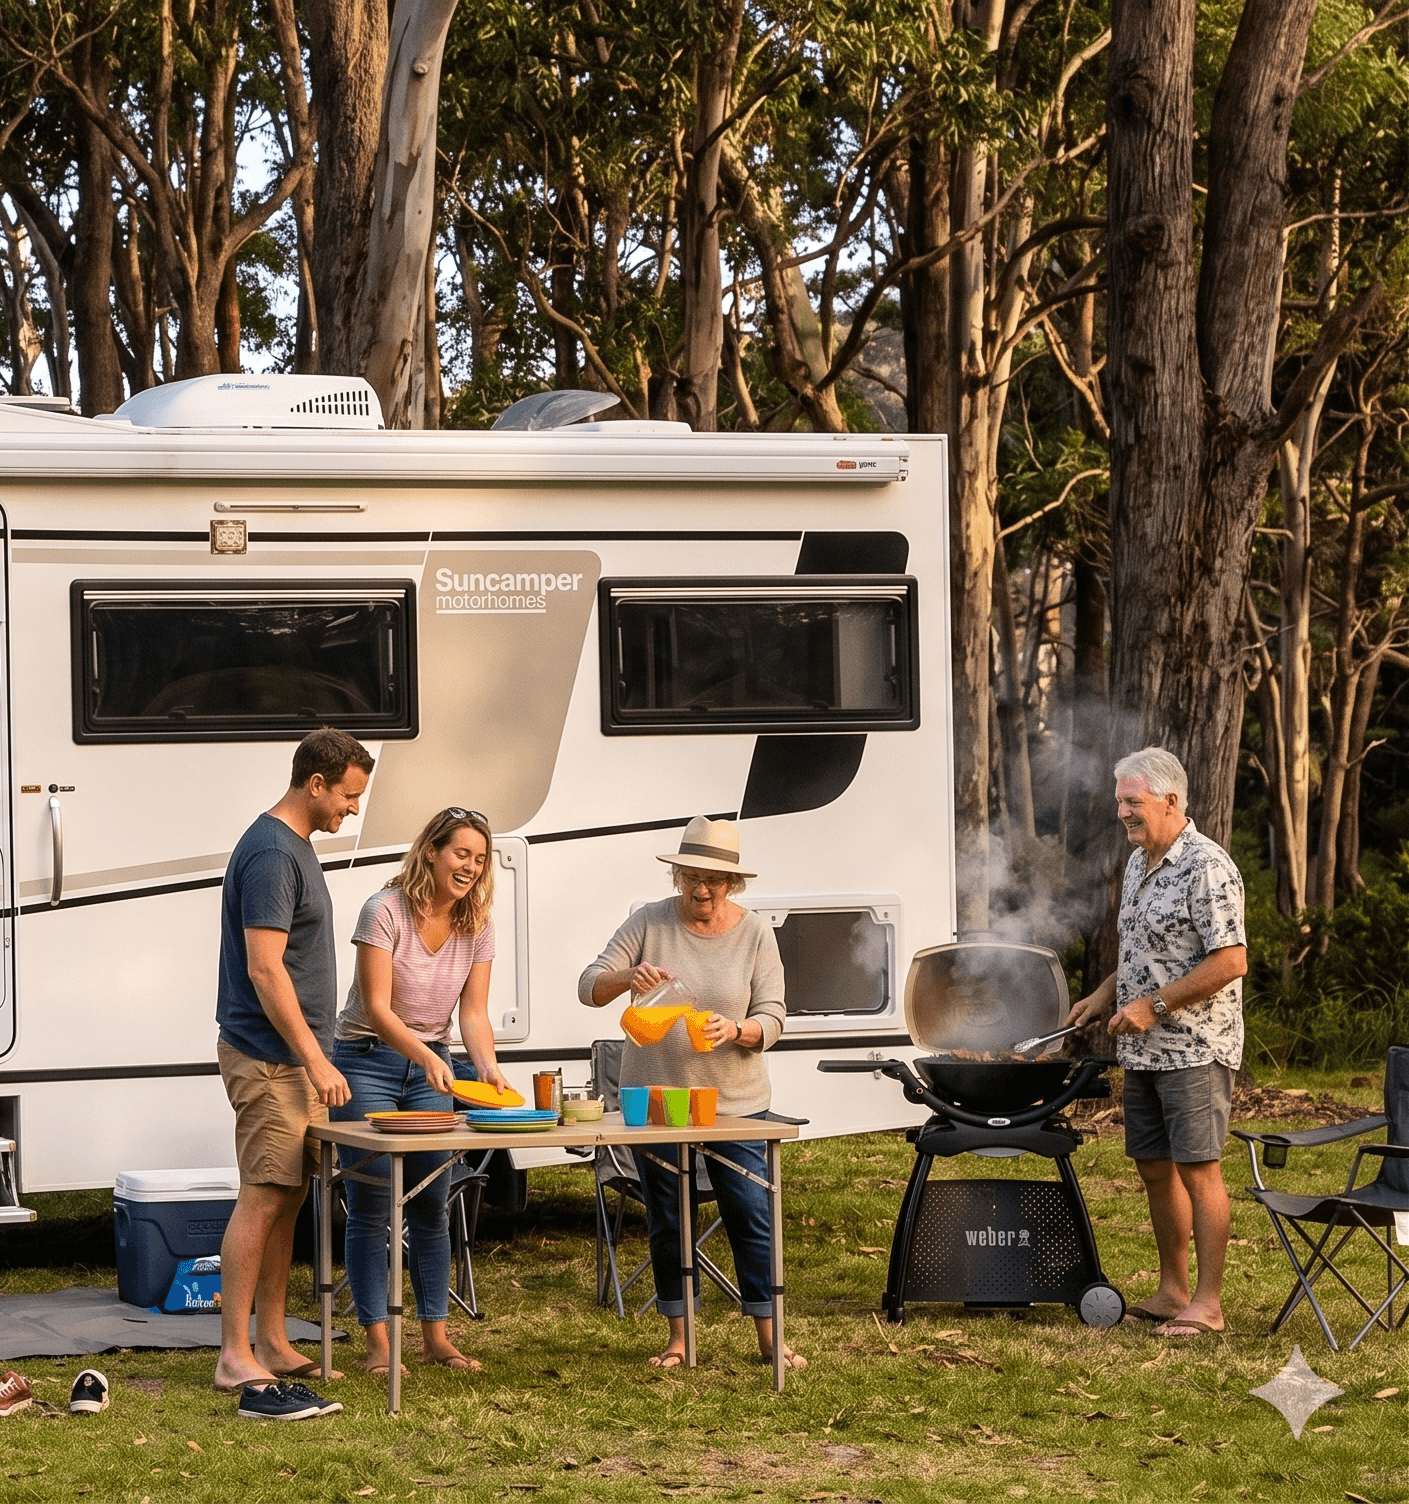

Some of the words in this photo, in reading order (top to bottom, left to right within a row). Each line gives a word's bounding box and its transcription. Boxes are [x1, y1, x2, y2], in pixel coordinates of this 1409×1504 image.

[435, 567, 583, 597] Suncamper
[435, 592, 546, 609] motorhomes
[965, 1226, 1016, 1247] weber
